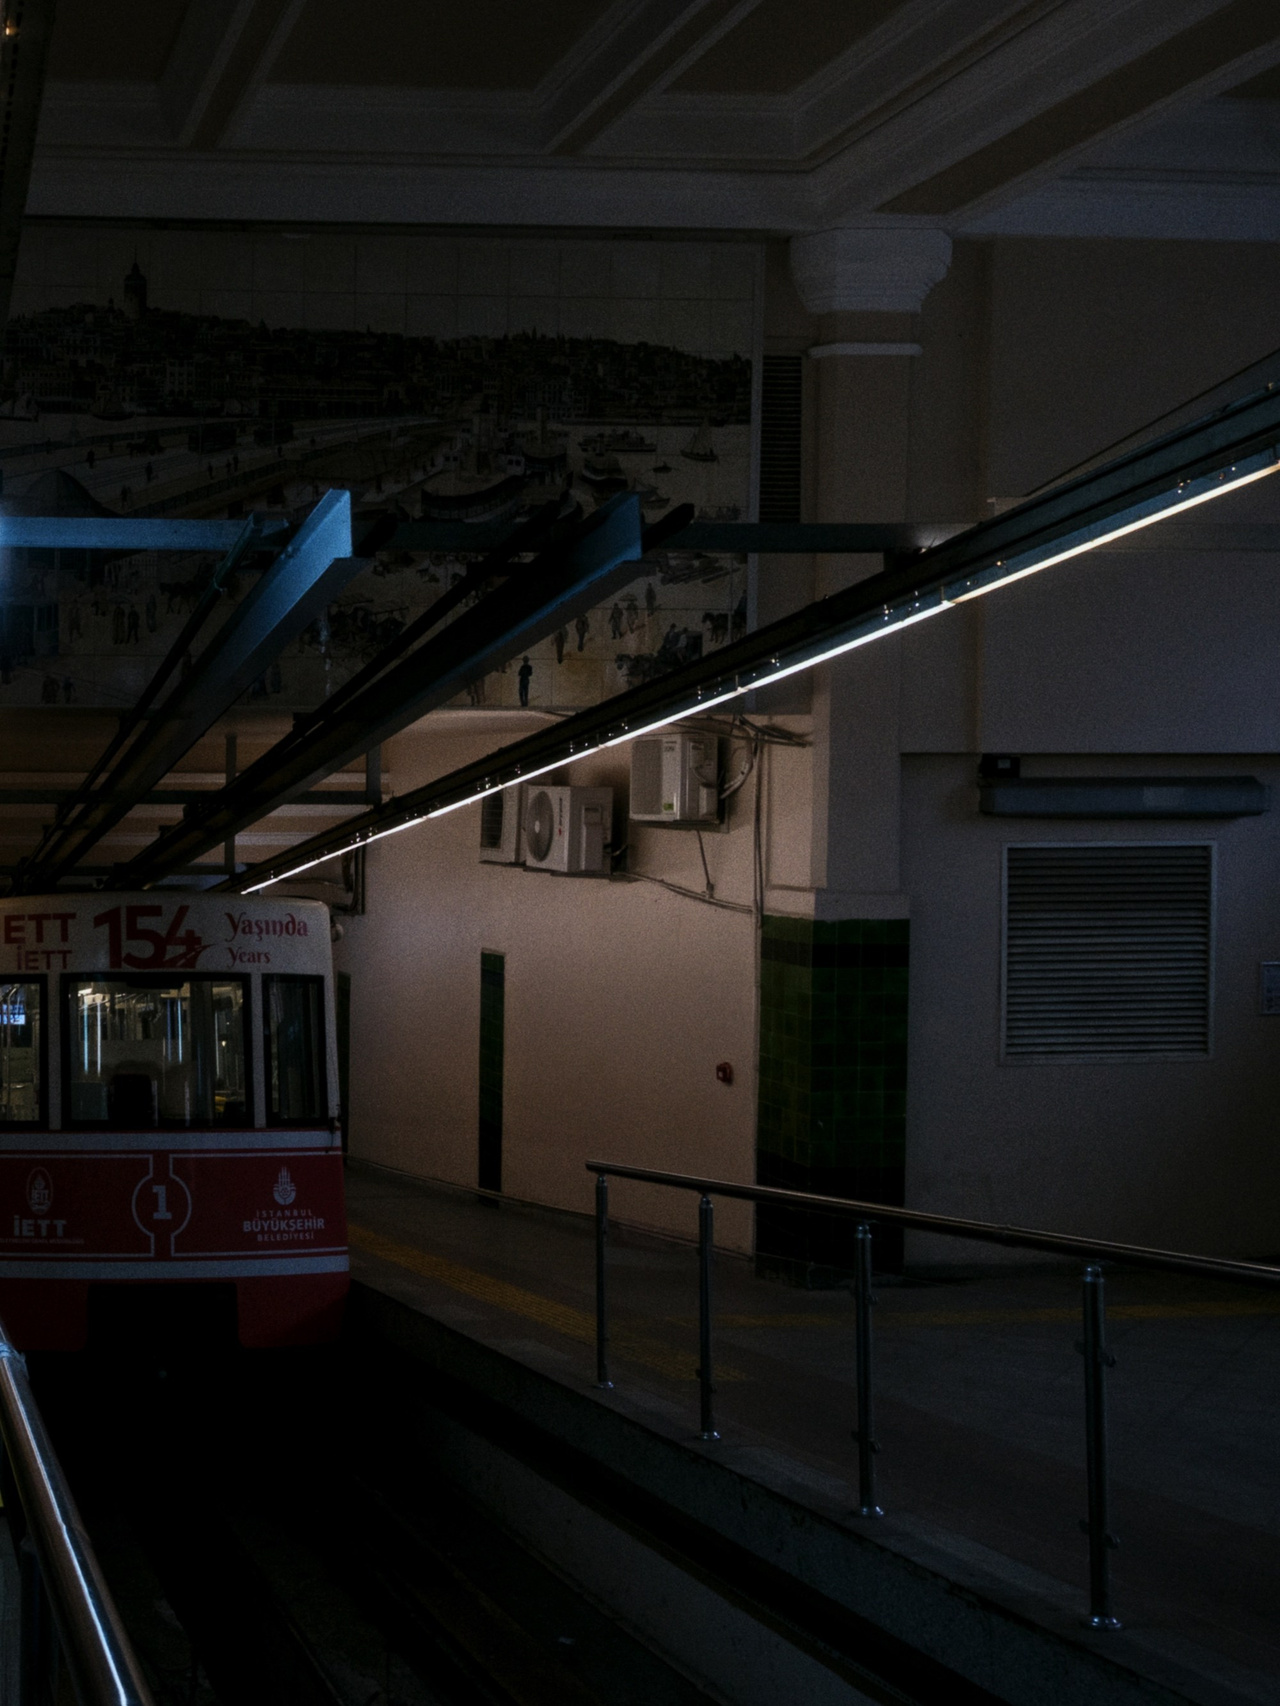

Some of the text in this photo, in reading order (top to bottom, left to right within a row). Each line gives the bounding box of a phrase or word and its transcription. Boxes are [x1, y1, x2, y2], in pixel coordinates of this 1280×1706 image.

[93, 905, 204, 969] 154
[224, 911, 309, 942] Yaşında
[16, 945, 271, 970] İETT Years
[152, 1185, 173, 1220] 1
[255, 1209, 314, 1218] İSTANBUL
[13, 1214, 68, 1237] İETT
[242, 1216, 326, 1233] BÜYÜKŞEHİR
[256, 1231, 315, 1242] BELEDİYESİ
